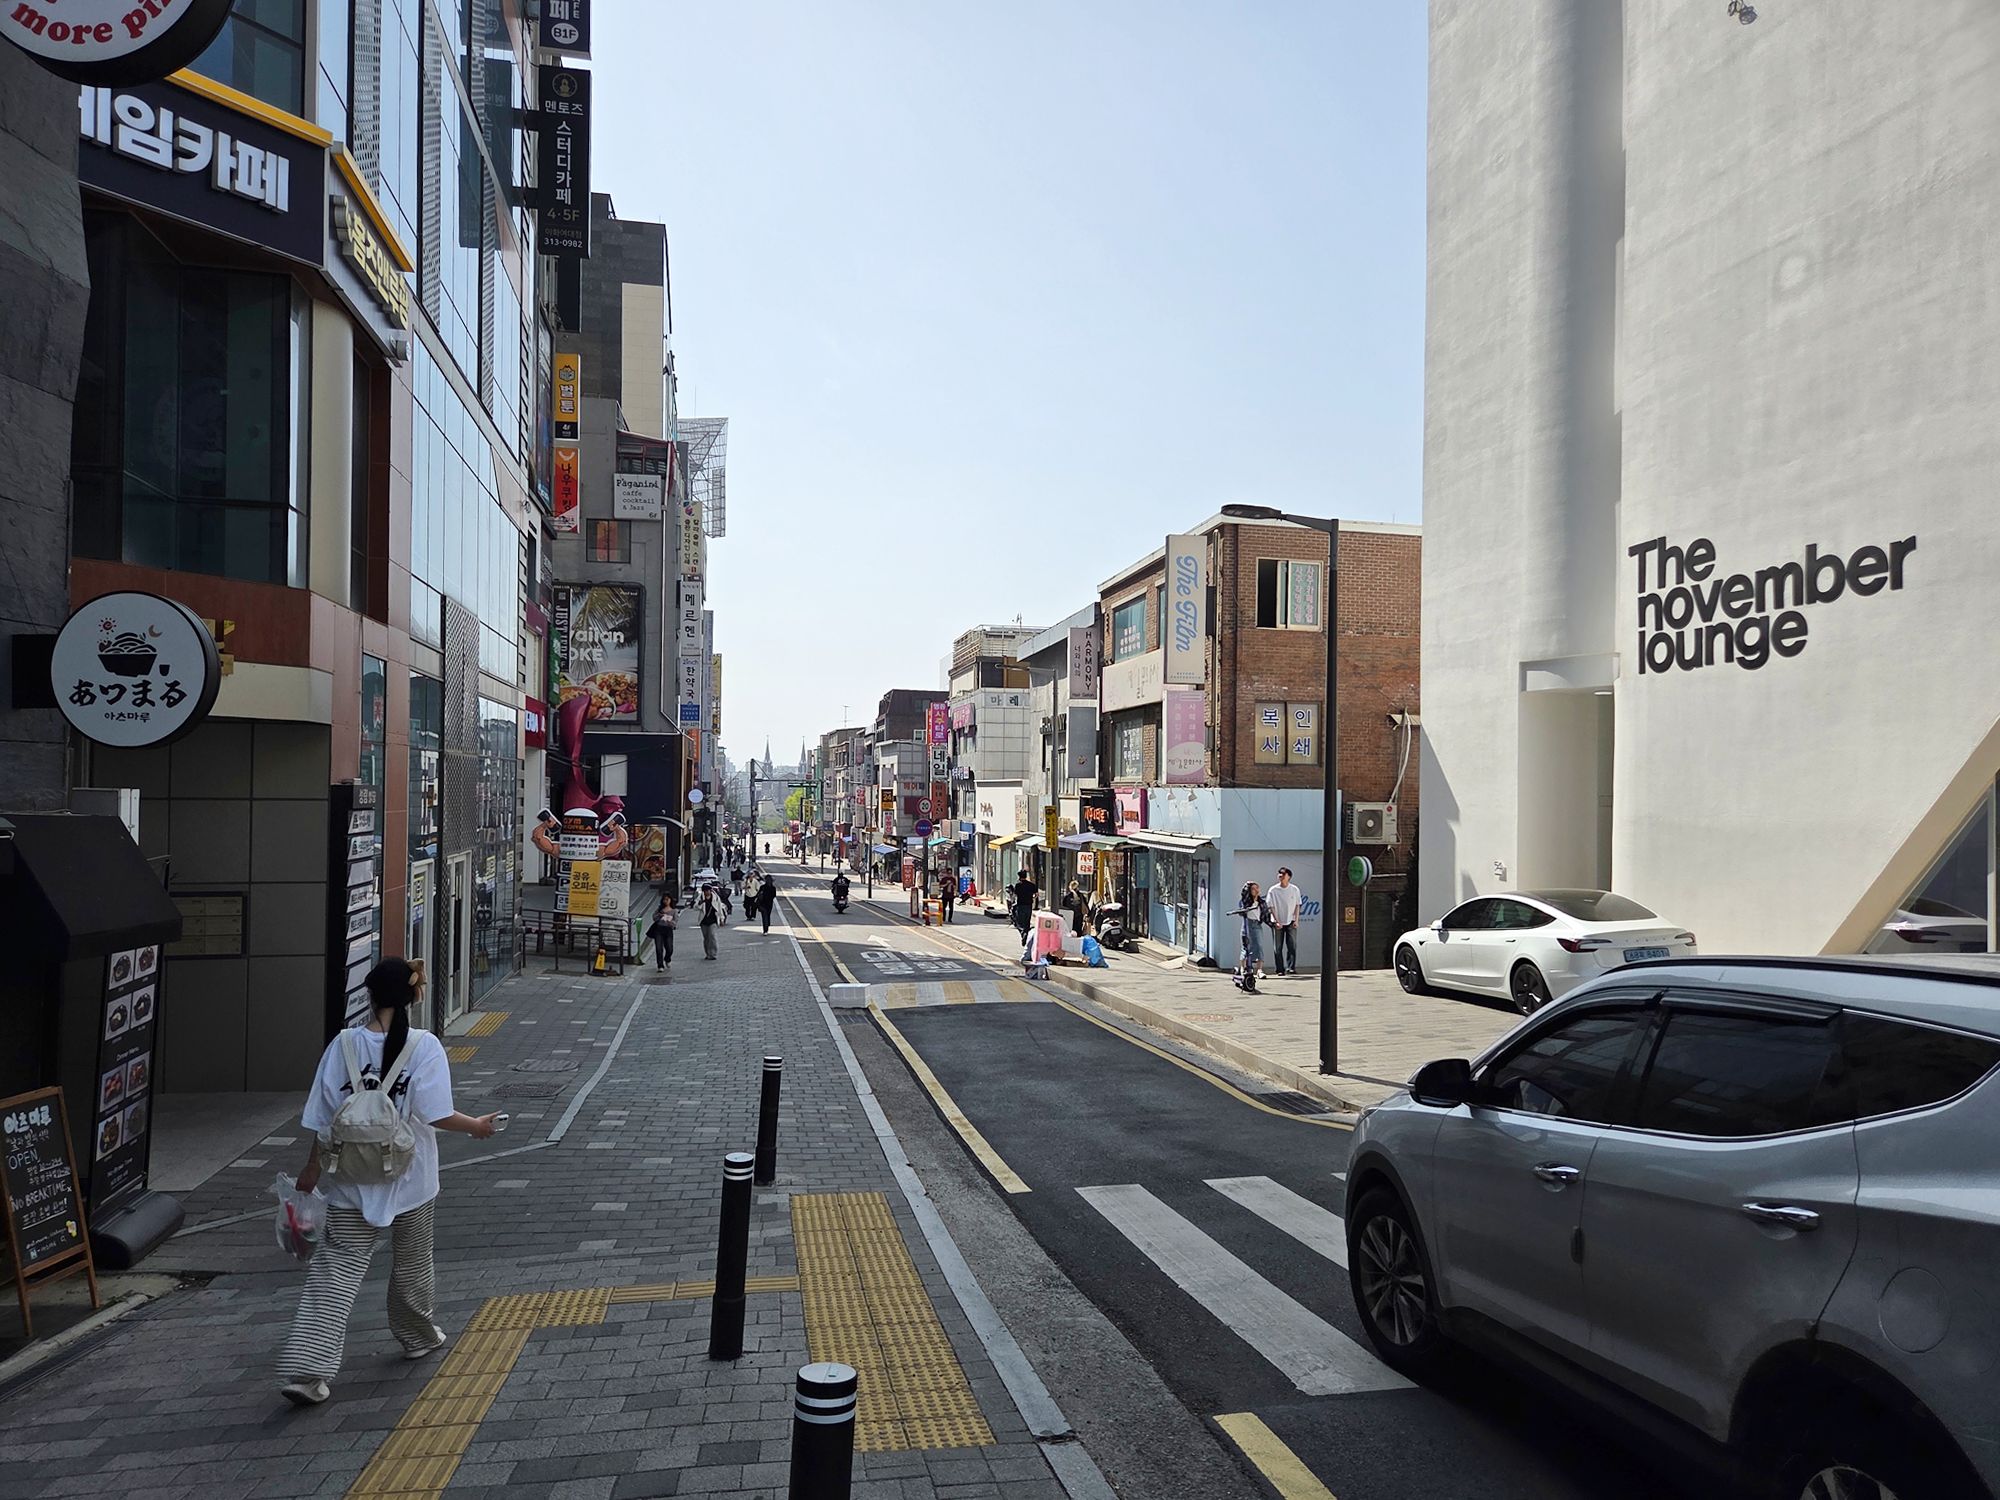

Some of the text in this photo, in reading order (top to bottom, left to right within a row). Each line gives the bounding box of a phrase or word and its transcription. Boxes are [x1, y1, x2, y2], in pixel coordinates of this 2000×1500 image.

[10, 0, 172, 44] more pi
[572, 0, 580, 19] FE
[553, 28, 576, 39] B1F
[544, 100, 584, 115] 멘토즈
[556, 120, 572, 205] 스터디카페
[544, 237, 583, 249] 313-0982
[561, 463, 572, 511] 나우쿠킹
[616, 479, 659, 489] Paganini
[1176, 555, 1199, 597] The
[1628, 536, 1716, 594] The
[1638, 535, 1917, 630] november
[1175, 601, 1198, 653] Film
[1638, 610, 1808, 674] lounge
[69, 679, 188, 708] あつまる
[685, 666, 696, 699] 한약국
[104, 711, 151, 722] 아츠마루
[1262, 708, 1280, 755] 복사
[1293, 709, 1312, 757] 인쇄
[933, 750, 945, 776] 네일
[571, 881, 598, 891] 오피스
[572, 871, 590, 881] 공유
[4, 1105, 52, 1134] 아츠마루
[8, 1148, 39, 1170] OPEN
